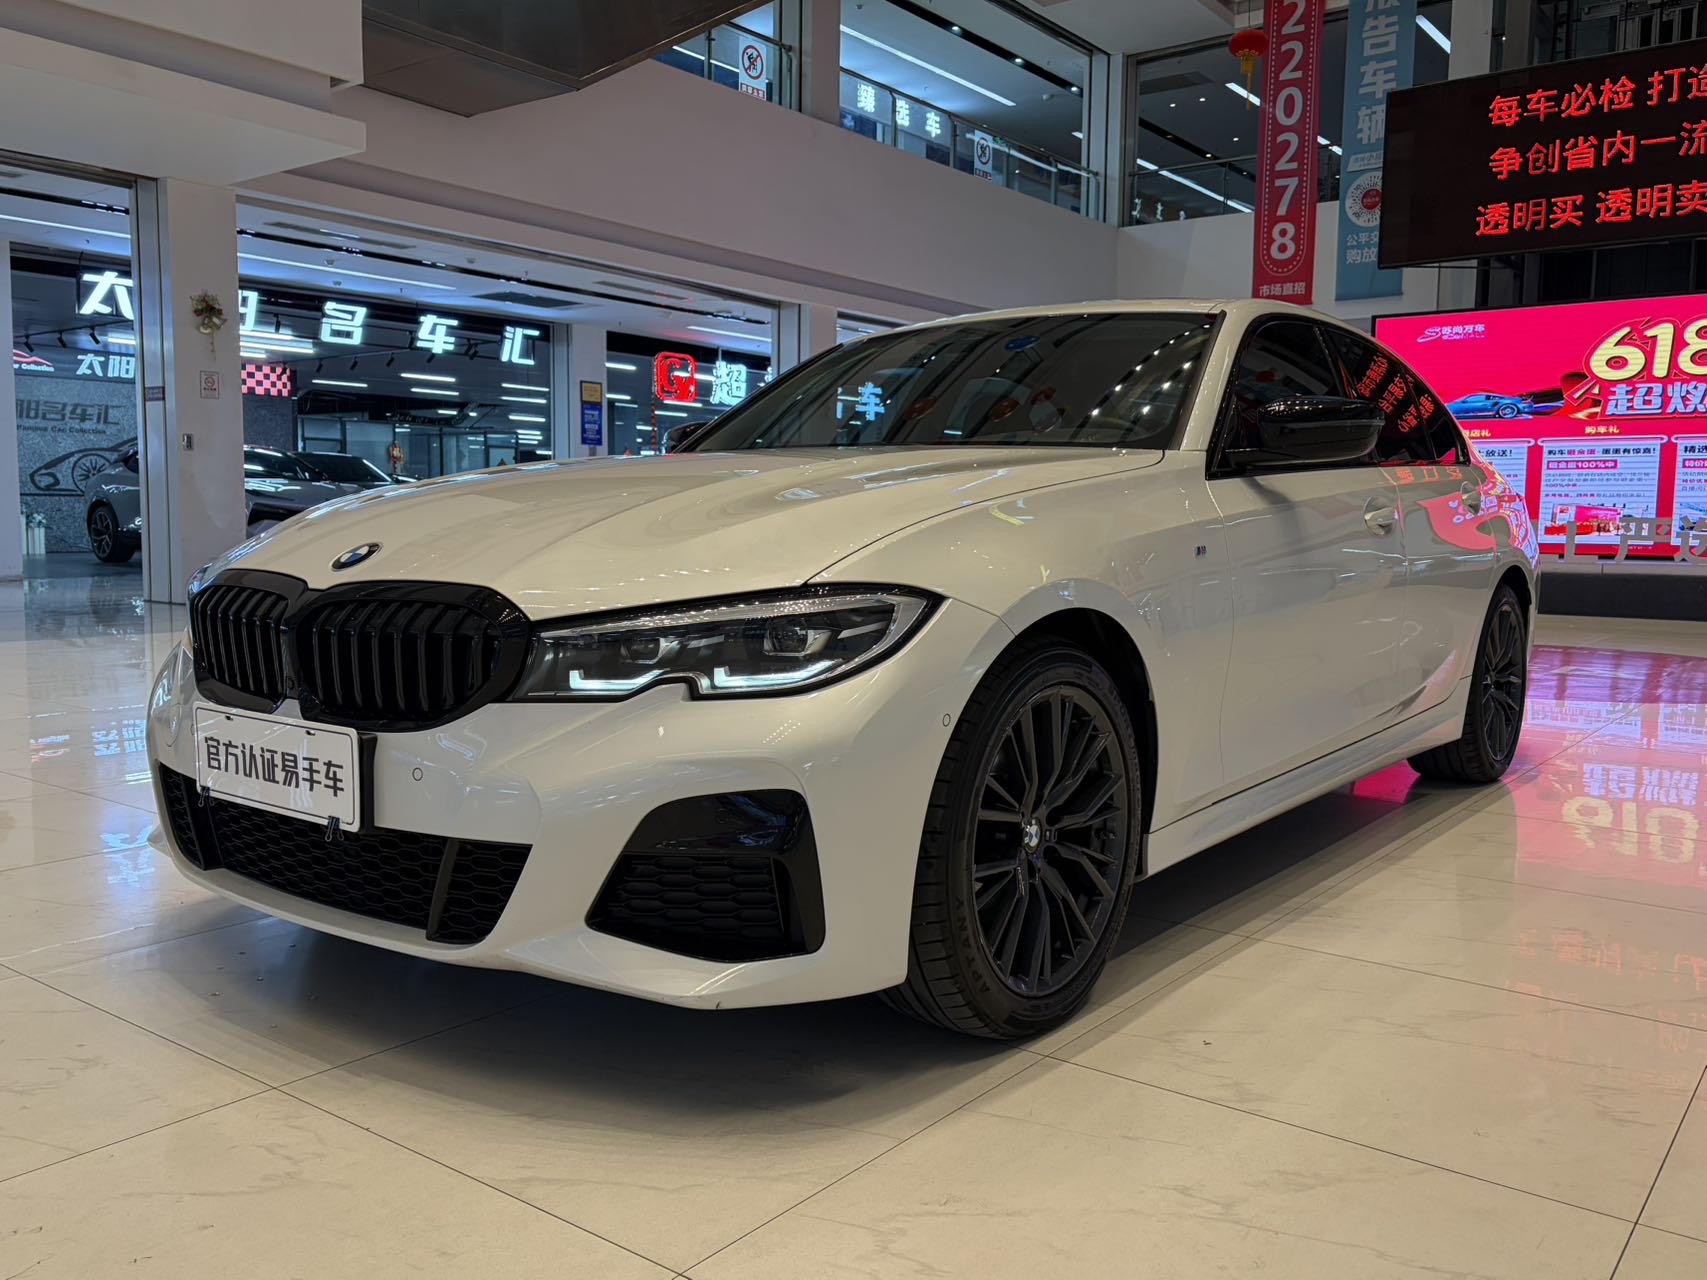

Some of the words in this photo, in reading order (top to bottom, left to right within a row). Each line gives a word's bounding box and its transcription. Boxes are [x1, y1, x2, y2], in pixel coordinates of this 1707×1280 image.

[1356, 0, 1400, 146] 告车辆
[1489, 75, 1636, 127] 每车必检
[1647, 63, 1707, 106] 打造
[1489, 119, 1707, 180] 争创省内一流
[1475, 194, 1584, 236] 透明买
[1595, 180, 1707, 224] 透明卖
[76, 353, 136, 379] 太阳
[1590, 318, 1707, 381] 618
